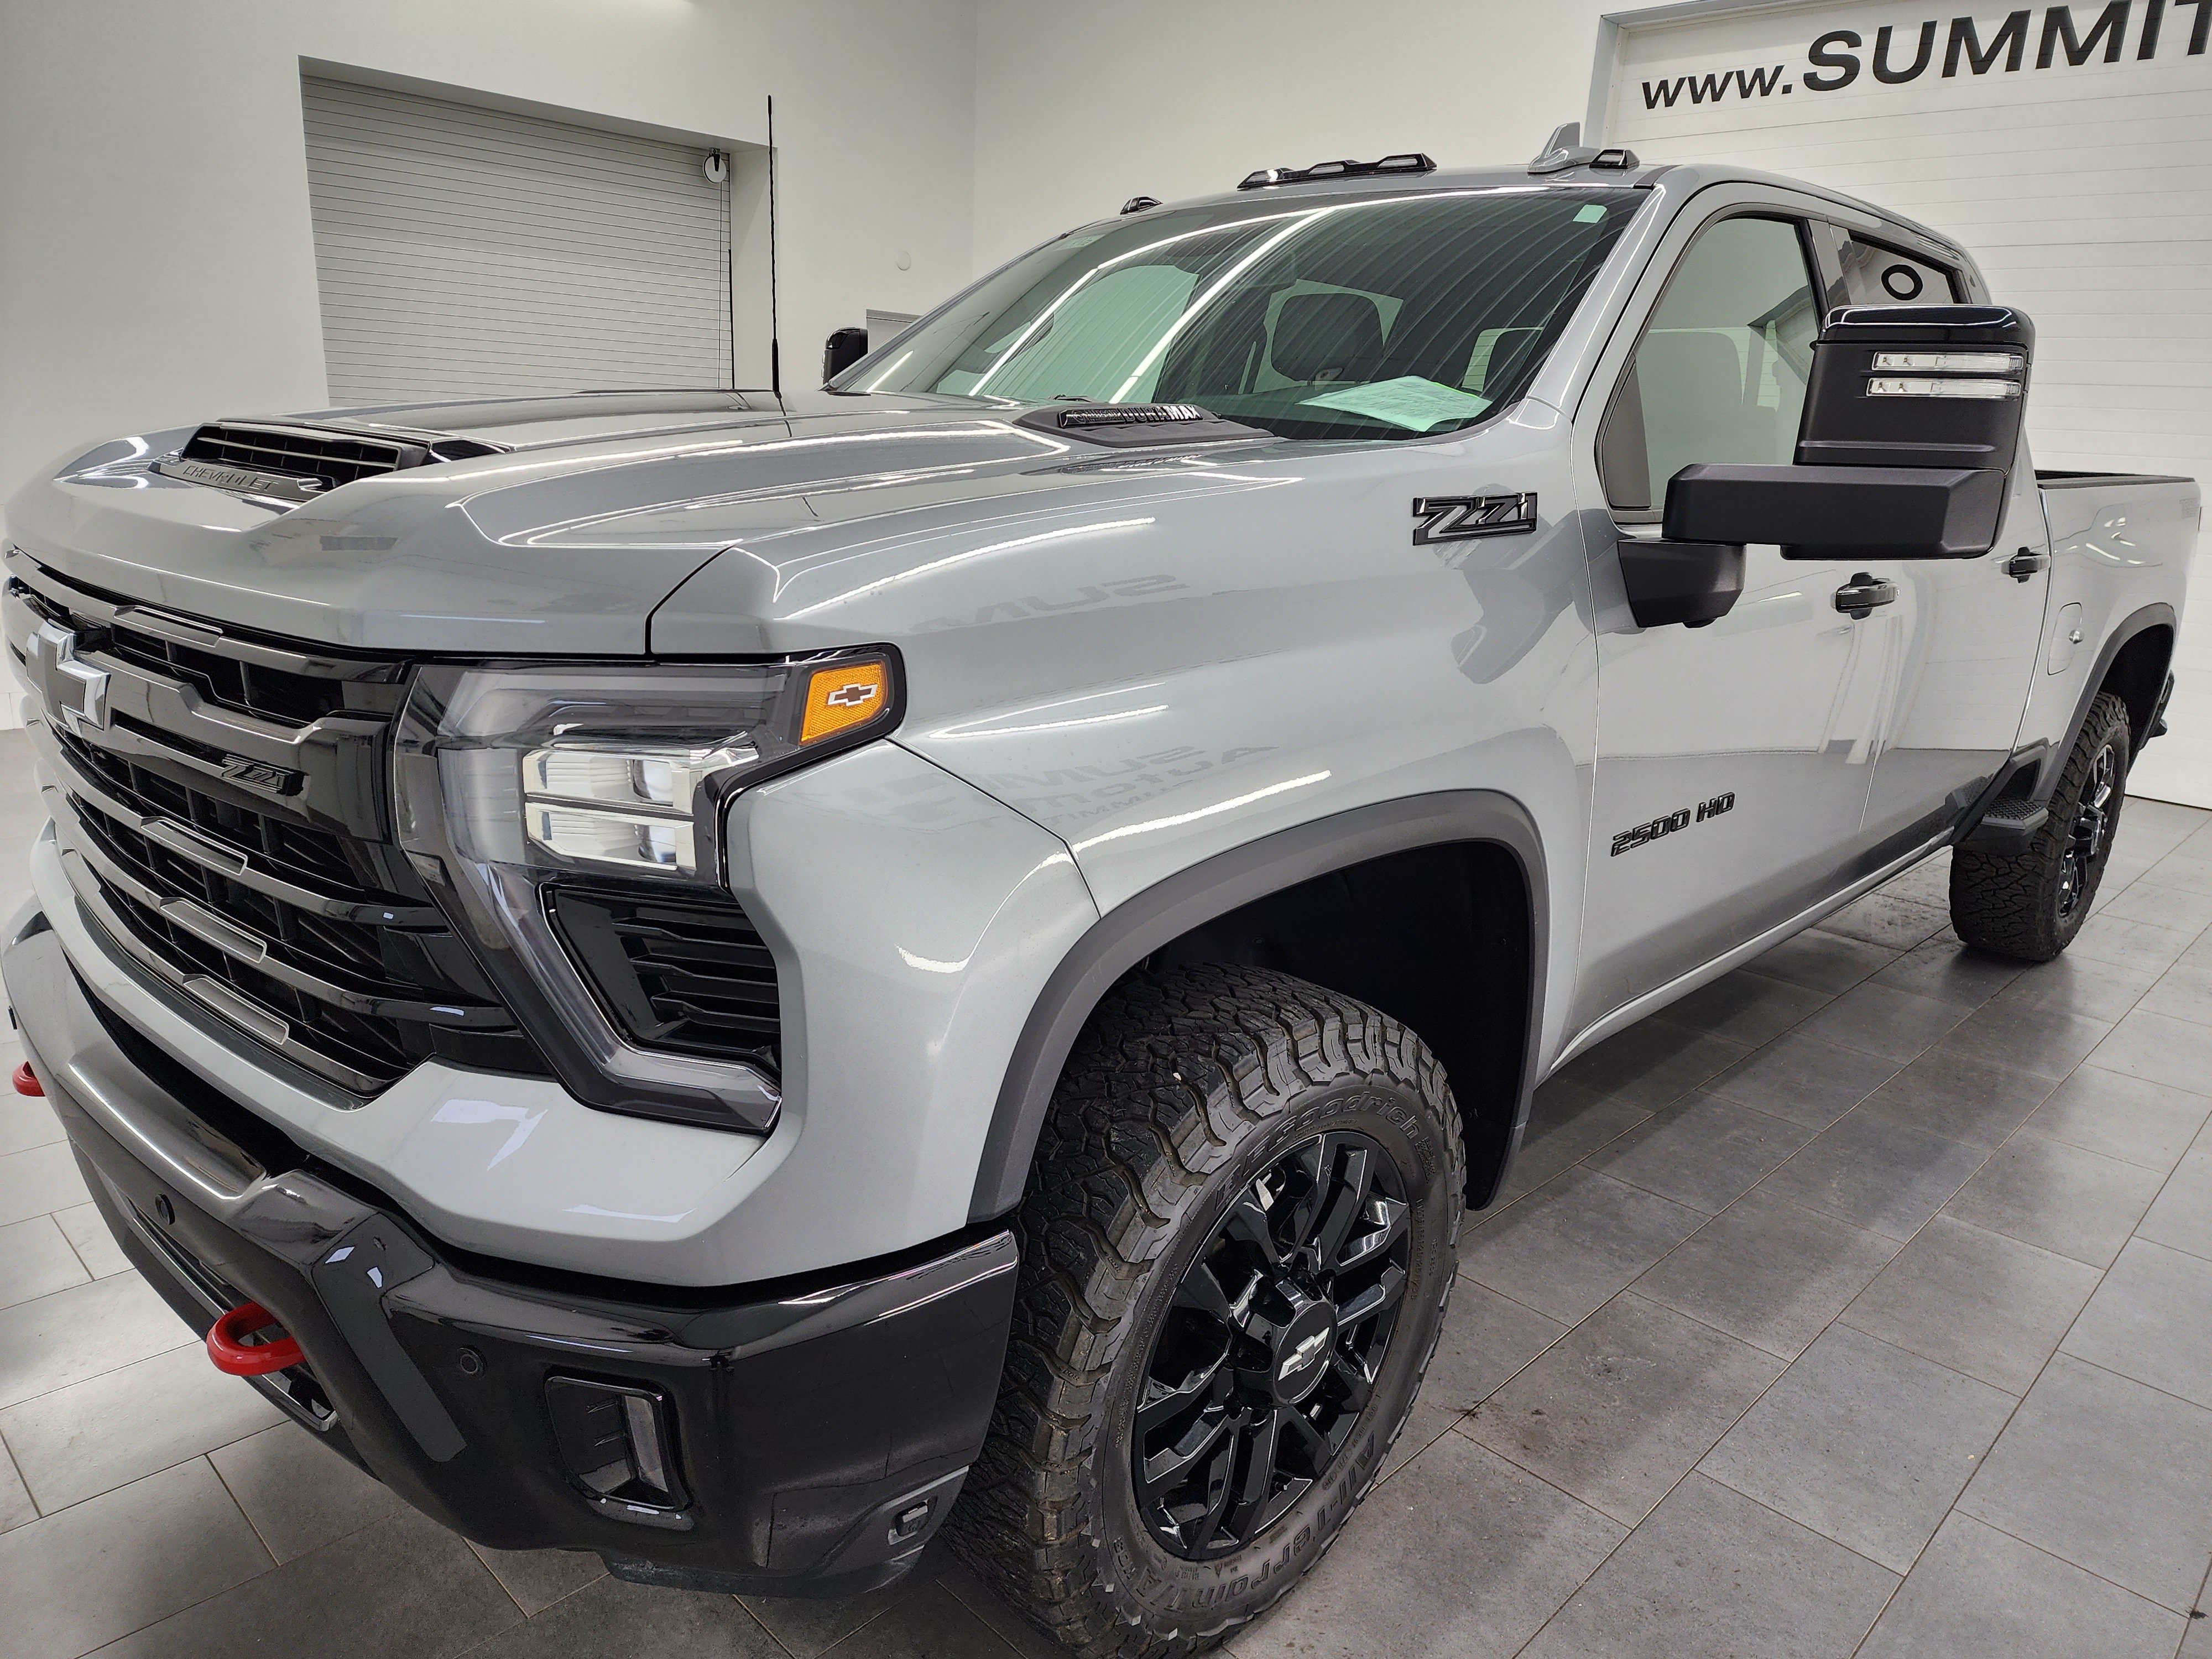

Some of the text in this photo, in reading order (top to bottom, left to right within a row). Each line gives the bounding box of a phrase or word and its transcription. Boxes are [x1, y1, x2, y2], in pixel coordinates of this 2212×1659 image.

[1120, 405, 1204, 425] DURAMAX
[182, 465, 279, 492] CHEVROLET
[1412, 491, 1538, 546] Z71
[1610, 791, 1735, 857] 2500 HD
